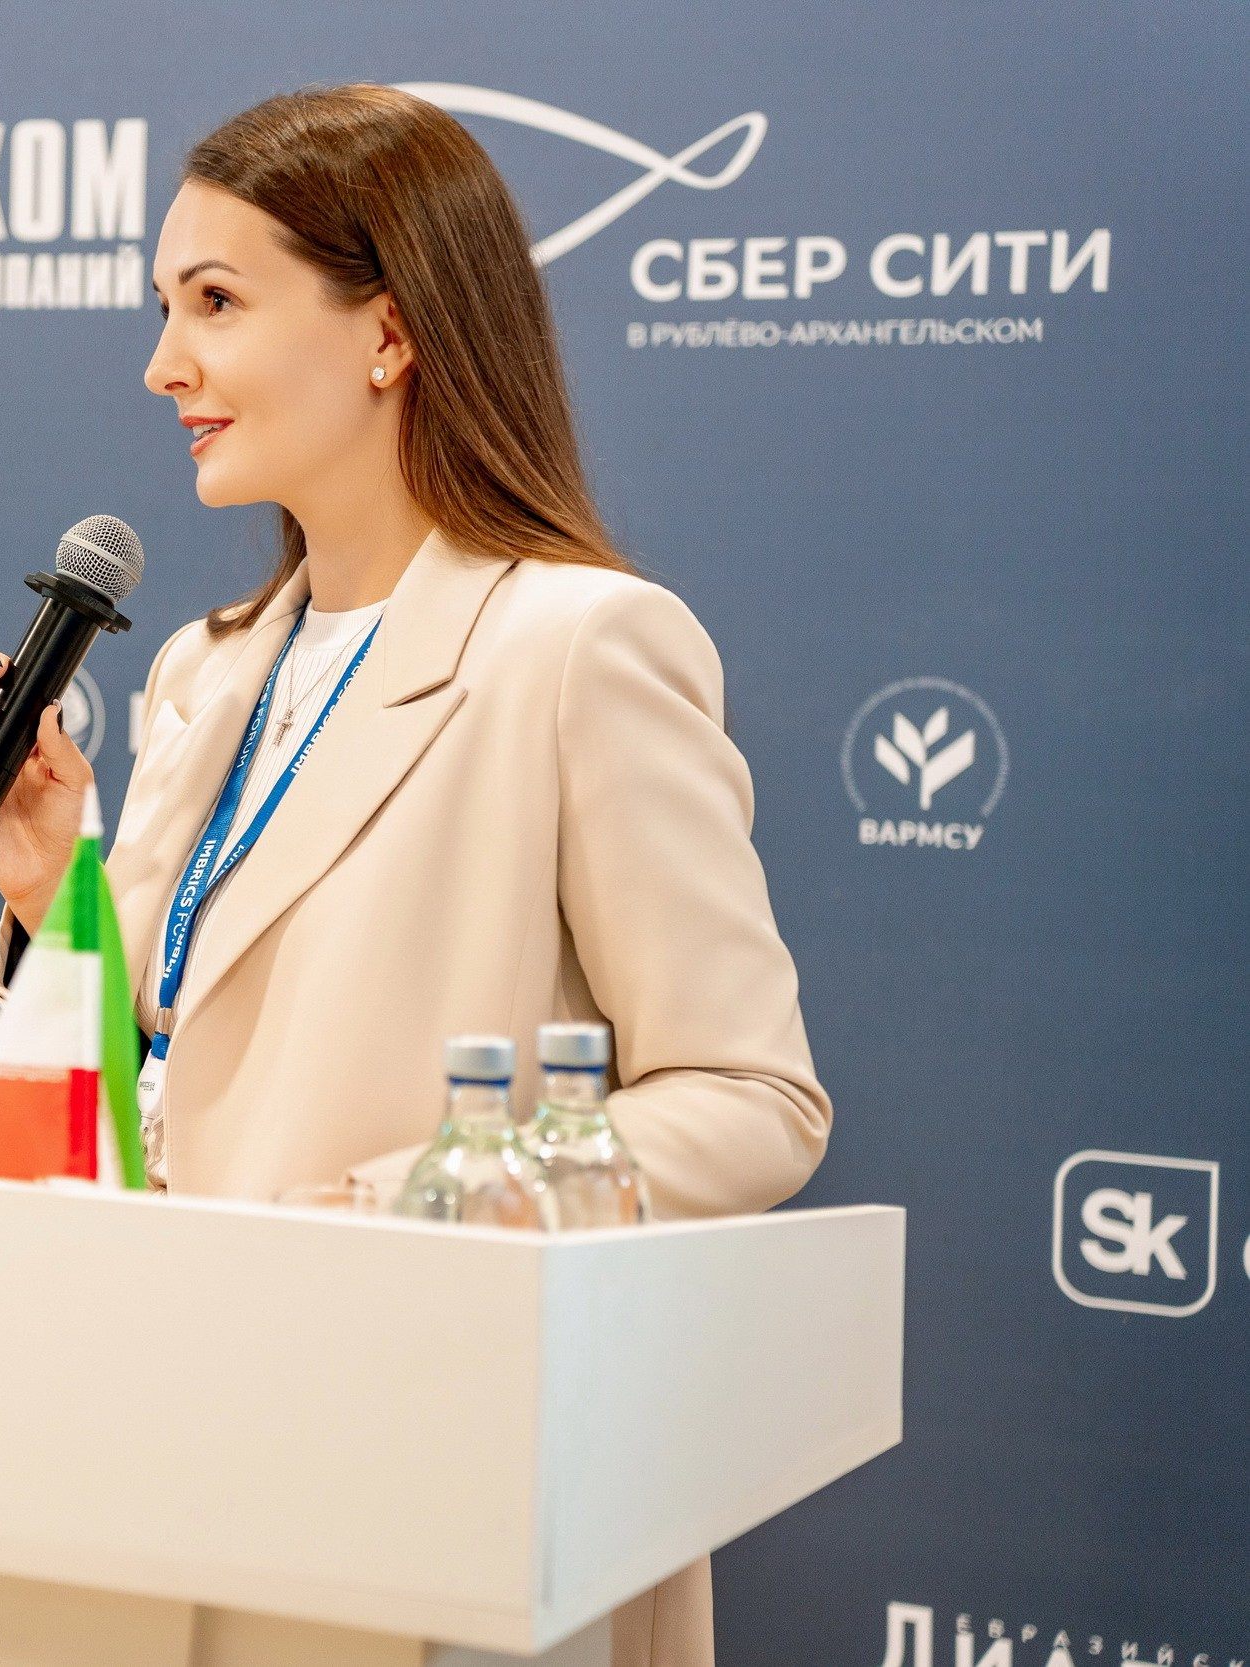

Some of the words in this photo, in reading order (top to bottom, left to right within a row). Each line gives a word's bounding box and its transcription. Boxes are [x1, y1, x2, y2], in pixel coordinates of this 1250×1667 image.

[630, 236, 847, 301] СБЕР
[869, 228, 1111, 297] СИТИ
[626, 321, 648, 349] В
[236, 706, 266, 769] FORUM
[859, 817, 984, 850] ВАРМСУ
[180, 839, 217, 908] IMBRICS
[1079, 1188, 1188, 1280] Sk
